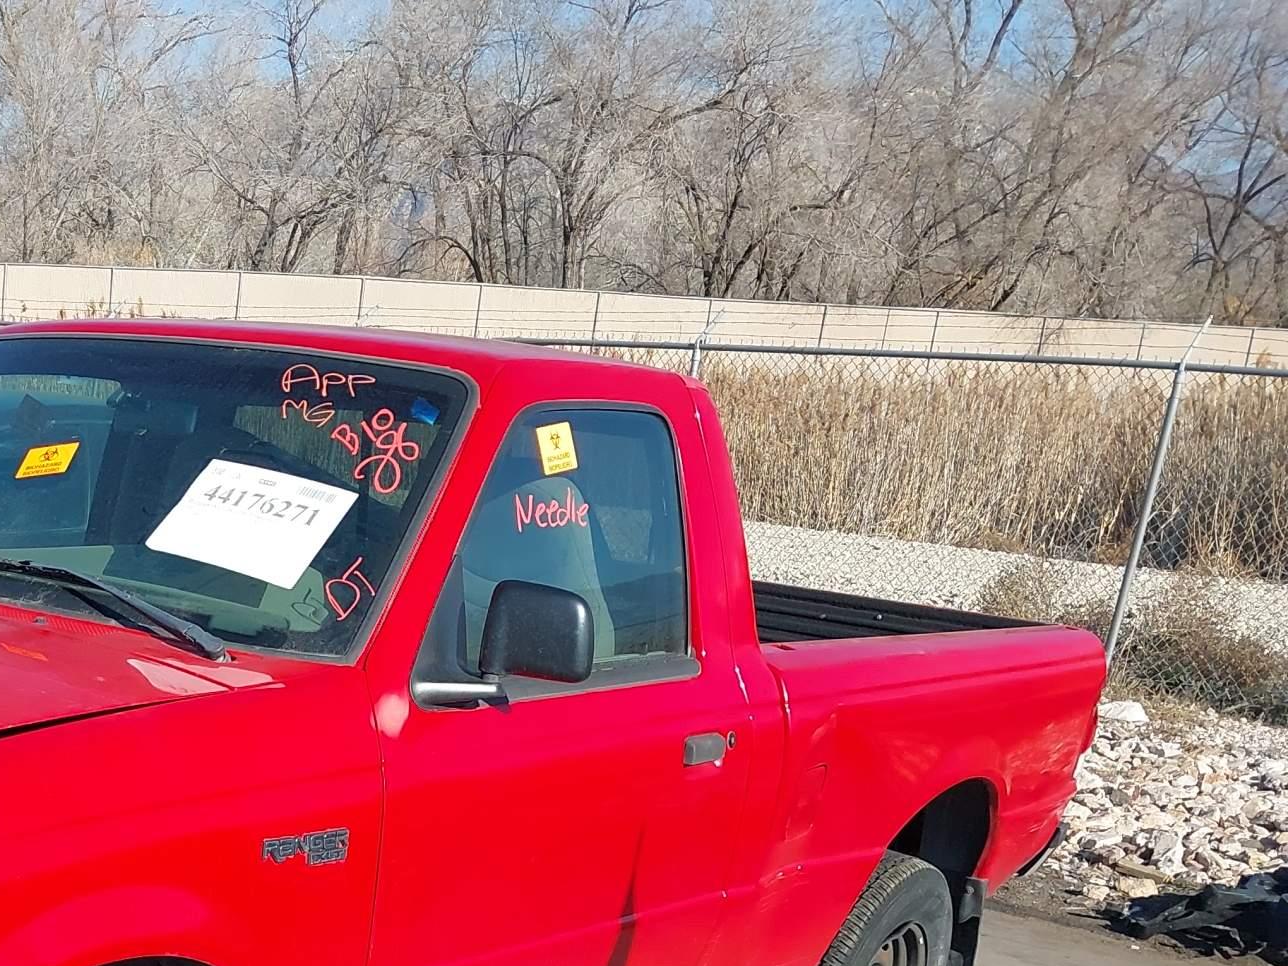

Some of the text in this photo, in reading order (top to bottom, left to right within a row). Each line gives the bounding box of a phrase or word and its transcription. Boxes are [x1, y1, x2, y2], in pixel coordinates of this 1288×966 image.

[203, 484, 321, 527] 44176271
[515, 486, 589, 533] Needle
[262, 828, 349, 863] RANGER
